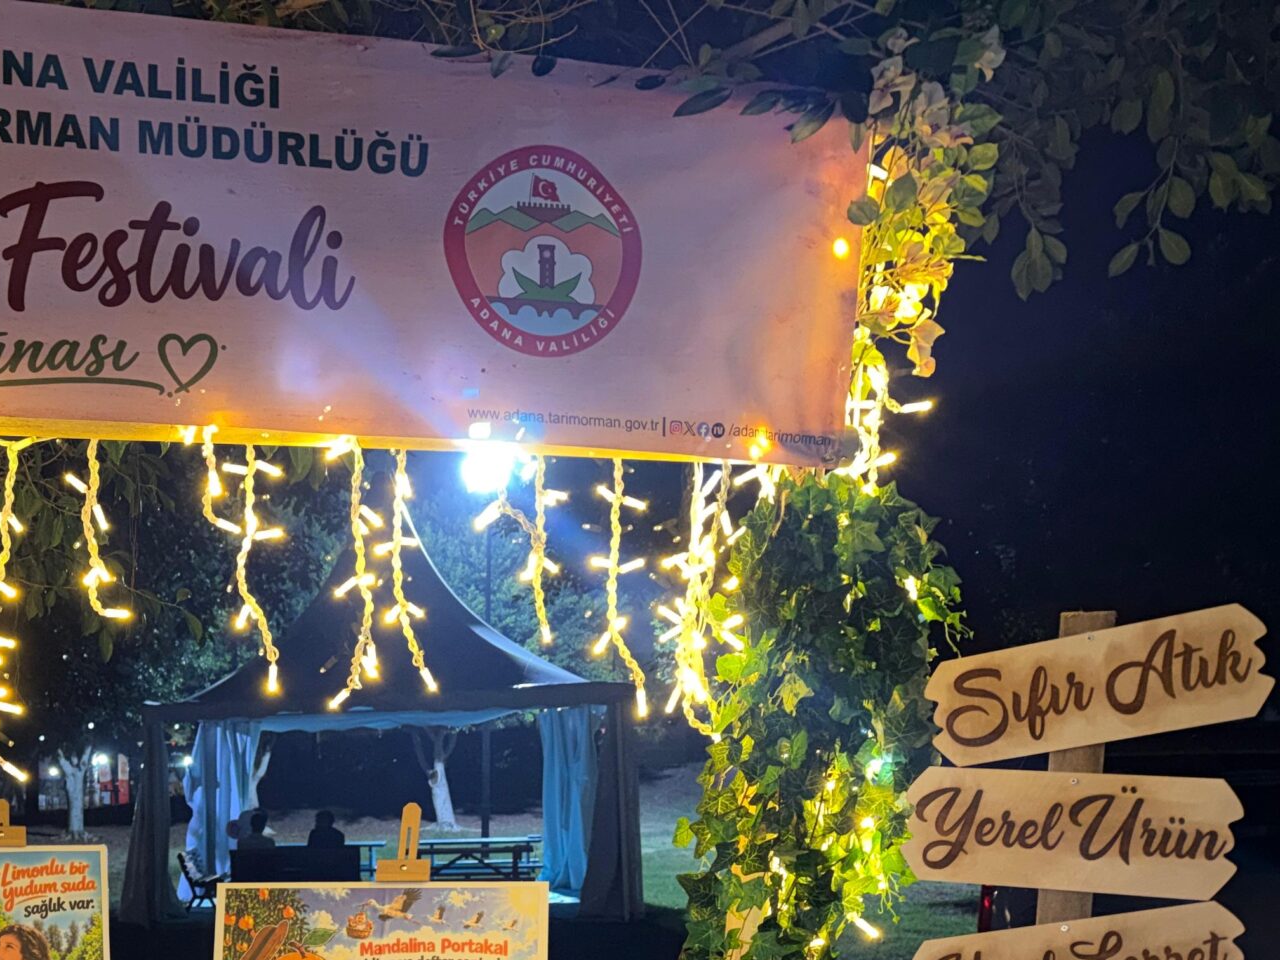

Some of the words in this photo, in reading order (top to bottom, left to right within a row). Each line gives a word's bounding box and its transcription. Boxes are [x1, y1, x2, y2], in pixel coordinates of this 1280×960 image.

[82, 57, 282, 110] VALİLİĞİ
[138, 116, 430, 178] MÜDÜRLÜĞÜ
[453, 158, 520, 228] TÜRKİYE
[528, 153, 634, 234] CUMHURİYETİ
[471, 296, 524, 347] ADANA
[535, 307, 616, 353] VALİLİĞİ
[945, 667, 1095, 748] Sıfır
[1105, 628, 1253, 716] Atık
[915, 786, 1064, 871] Yerel
[1068, 785, 1230, 867] Ürün
[1, 858, 68, 888] Limonlu
[69, 860, 91, 876] bir
[2, 879, 59, 913] yudum
[60, 875, 98, 894] suda
[23, 897, 67, 920] sağlık
[69, 898, 95, 911] var.
[359, 937, 436, 957] Mandalina
[440, 937, 509, 957] Portakal
